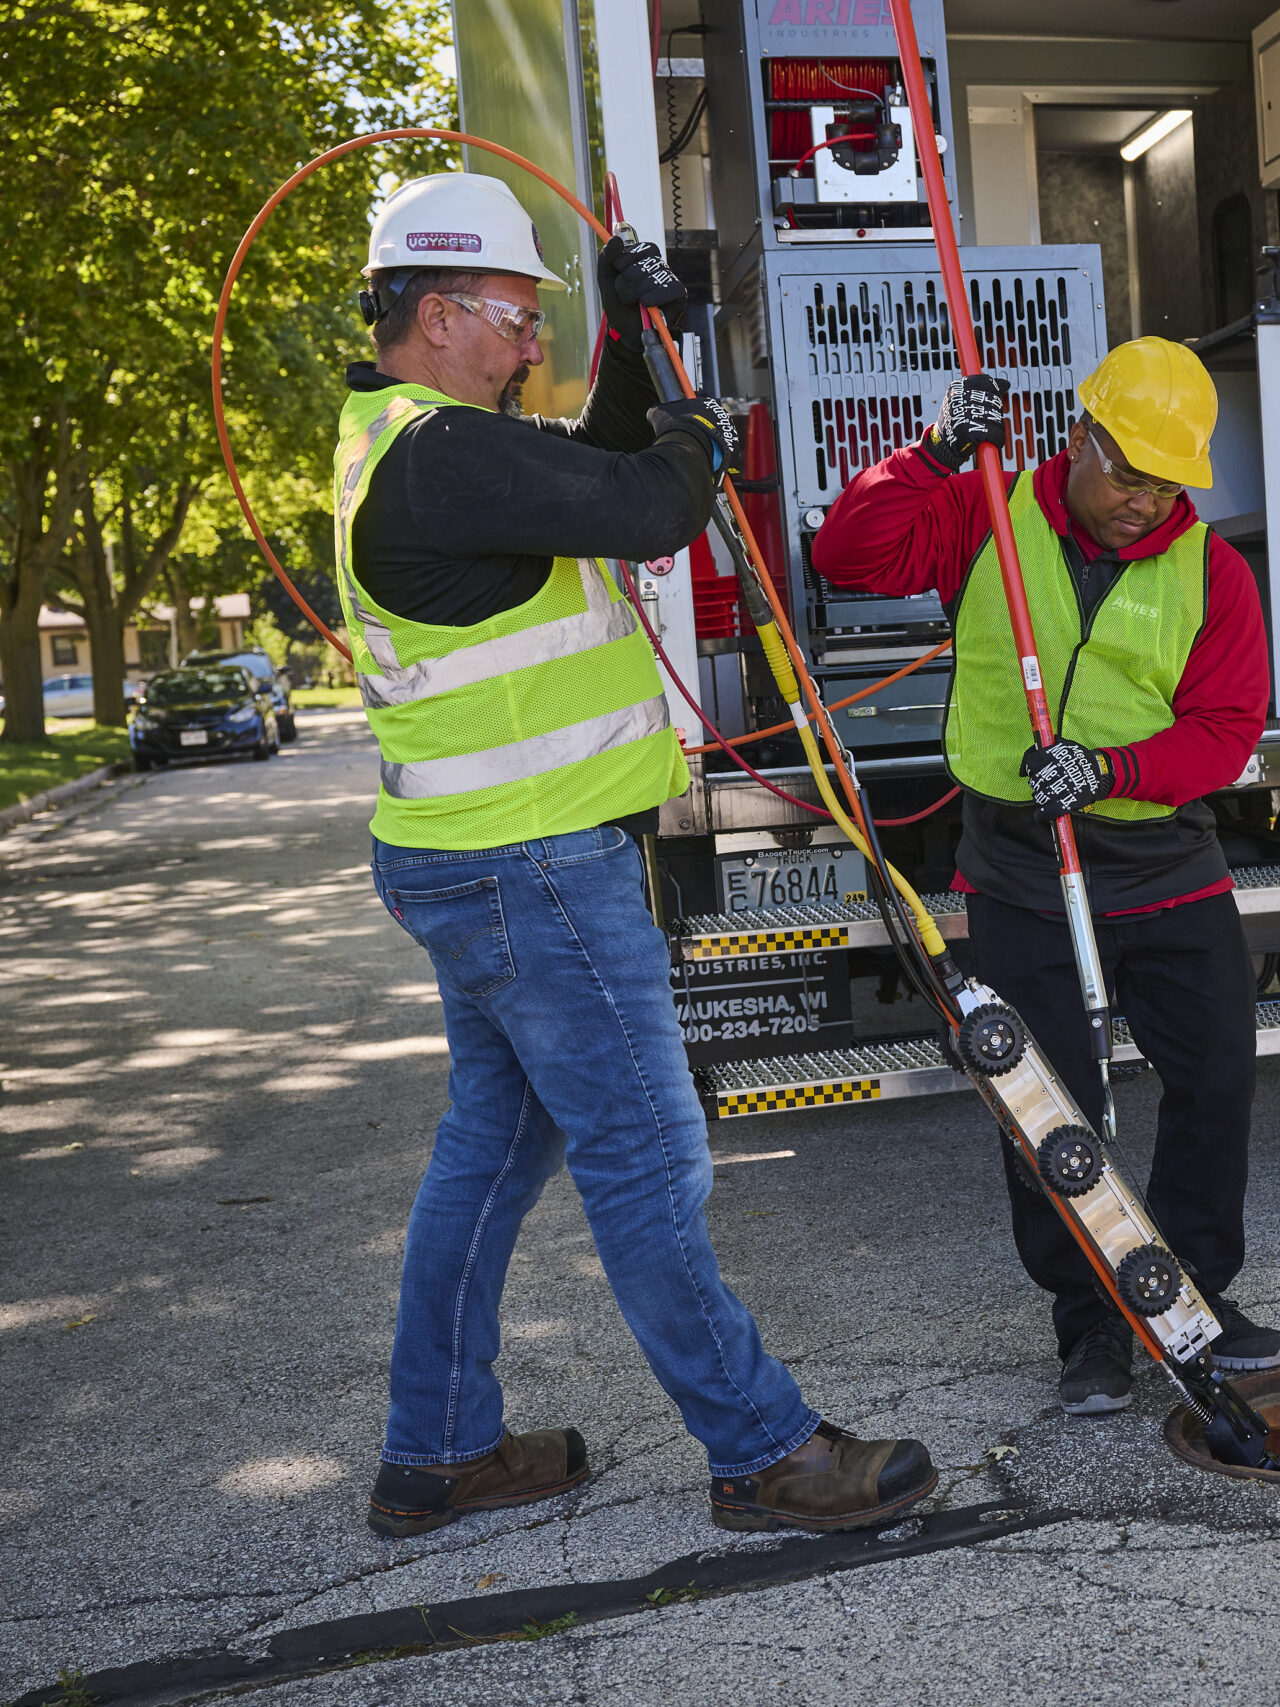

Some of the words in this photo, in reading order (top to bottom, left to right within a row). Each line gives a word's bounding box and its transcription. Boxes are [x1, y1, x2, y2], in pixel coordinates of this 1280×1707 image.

[408, 237, 479, 248] VOYAGER
[1111, 595, 1159, 618] ARIES
[777, 855, 812, 866] TRUCK
[751, 863, 839, 907] 76844
[671, 955, 786, 977] NDUSTRIES,
[790, 952, 827, 967] INC.
[799, 990, 828, 1011] WI
